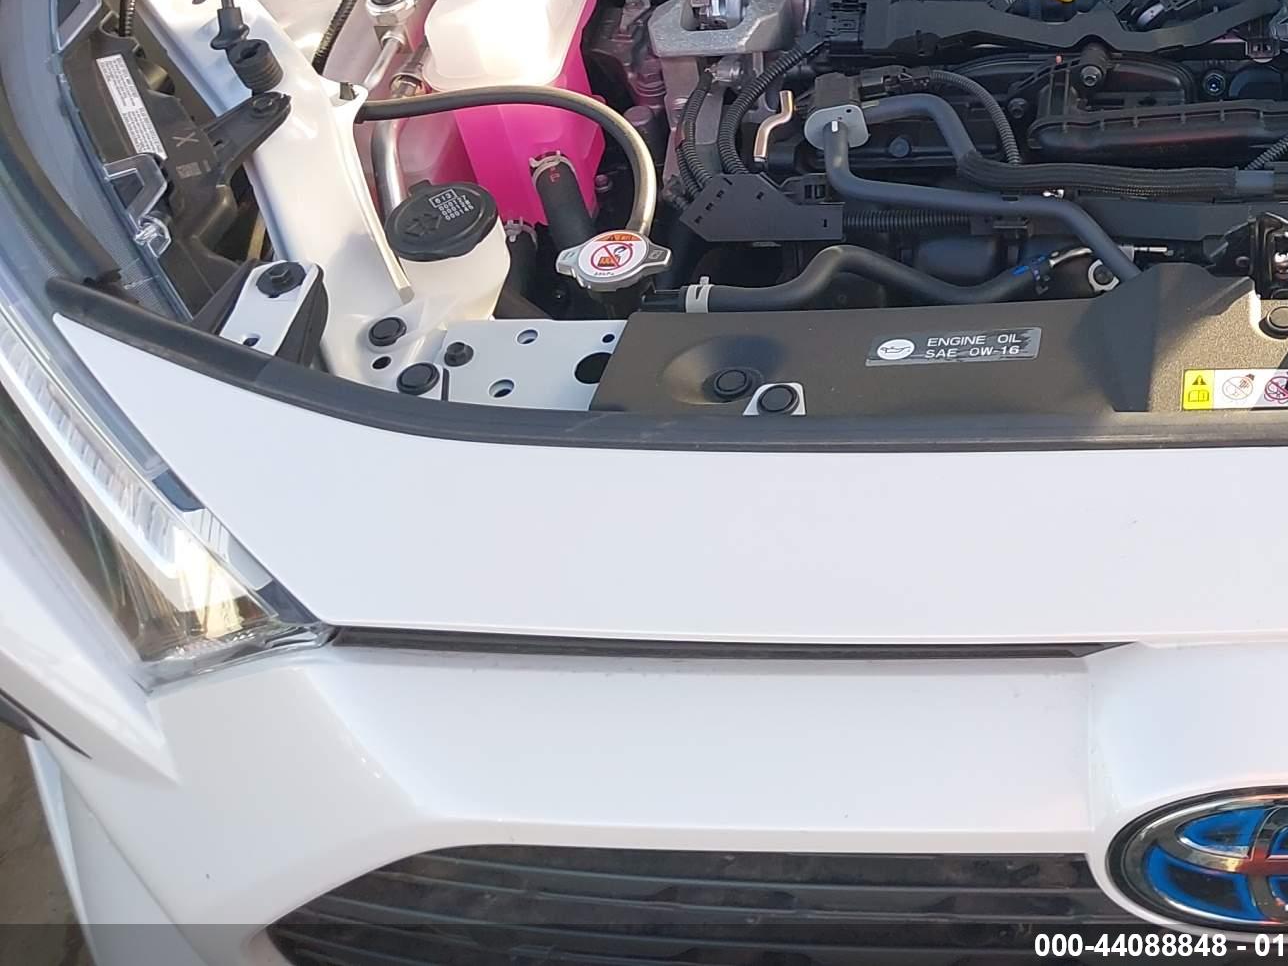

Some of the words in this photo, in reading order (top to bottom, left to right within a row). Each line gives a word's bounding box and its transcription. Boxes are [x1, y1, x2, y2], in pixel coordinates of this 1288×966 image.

[927, 335, 987, 347] ENGINE
[997, 333, 1022, 344] OIL
[924, 347, 958, 359] SAE
